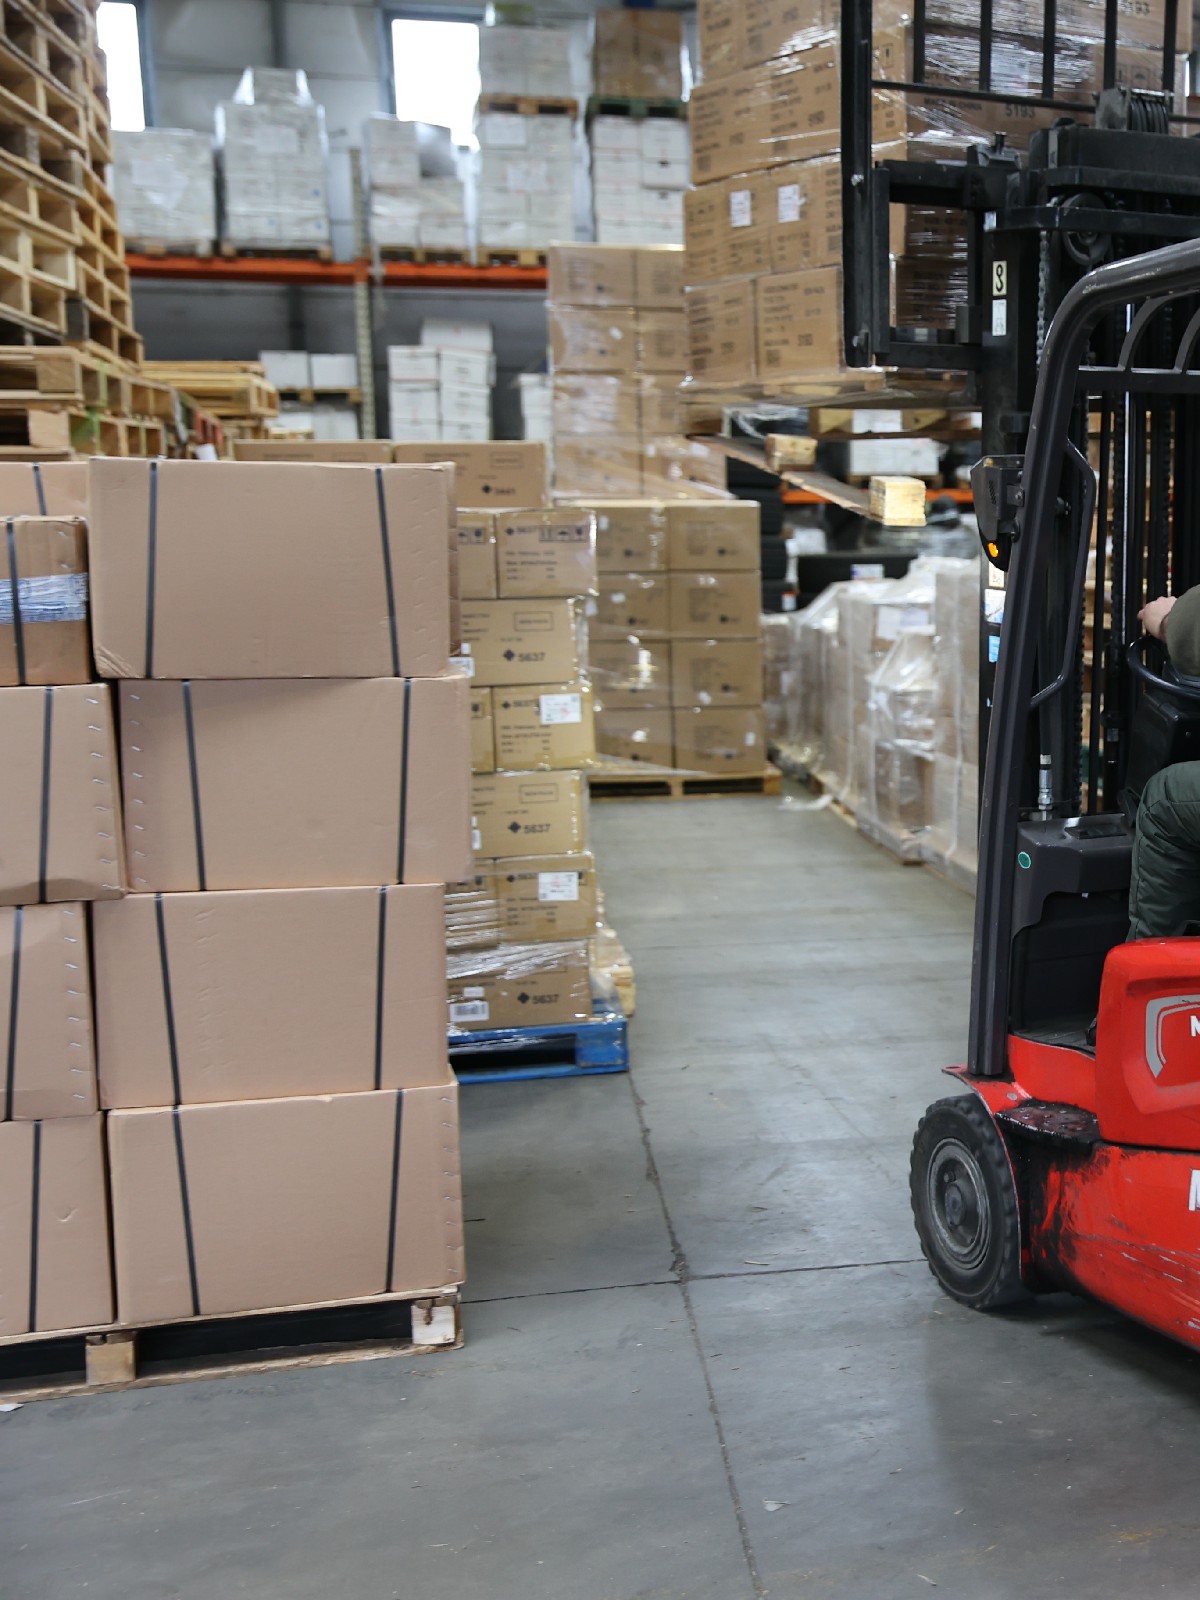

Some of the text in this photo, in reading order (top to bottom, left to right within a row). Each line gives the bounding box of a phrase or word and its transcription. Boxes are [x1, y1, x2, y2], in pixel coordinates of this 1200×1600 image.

[1005, 103, 1035, 119] 5193
[518, 652, 546, 662] 5637
[523, 823, 551, 834] 5637
[532, 993, 559, 1004] 5637
